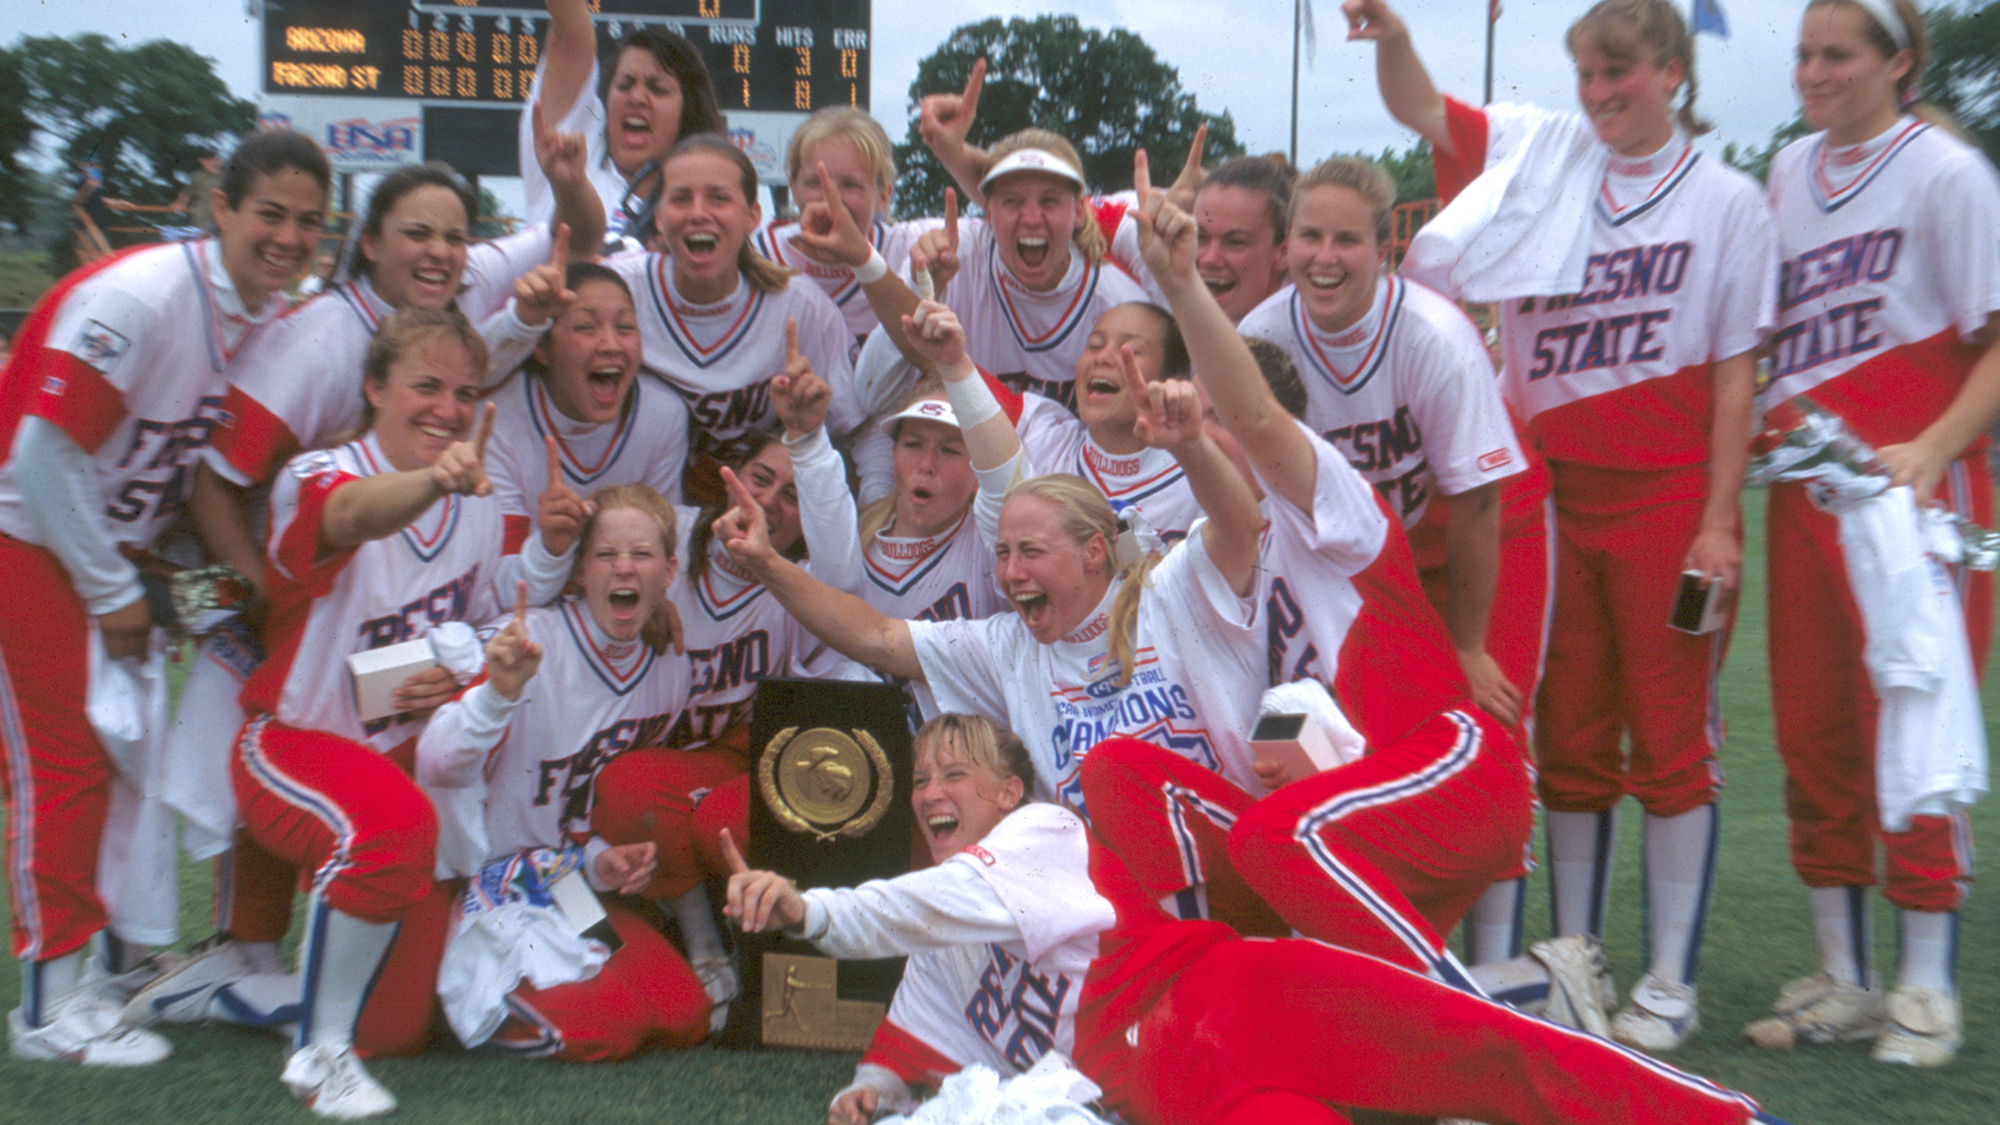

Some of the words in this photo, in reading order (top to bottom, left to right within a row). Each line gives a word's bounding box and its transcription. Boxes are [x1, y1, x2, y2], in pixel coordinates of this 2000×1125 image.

[433, 11, 450, 32] 2
[459, 12, 476, 33] 3
[495, 14, 511, 35] 4
[521, 15, 537, 36] 5
[709, 24, 757, 46] RUNS
[776, 26, 814, 48] HITS
[833, 28, 867, 49] ERR
[402, 29, 424, 60] 0
[429, 30, 450, 61] 0
[456, 31, 477, 62] 0
[491, 33, 512, 64] 0
[518, 34, 538, 65] 0
[733, 44, 750, 73] 0
[795, 46, 811, 76] 3
[841, 48, 857, 78] 0
[349, 64, 382, 90] ST
[403, 65, 424, 96] 0
[429, 66, 450, 96] 0
[456, 67, 477, 97] 0
[493, 69, 513, 99] 0
[742, 78, 750, 107] 1
[1517, 240, 1696, 314] ESNO
[1529, 307, 1674, 383] STATE
[1088, 444, 1141, 477] BULLDOGS
[1128, 666, 1168, 691] TBALL
